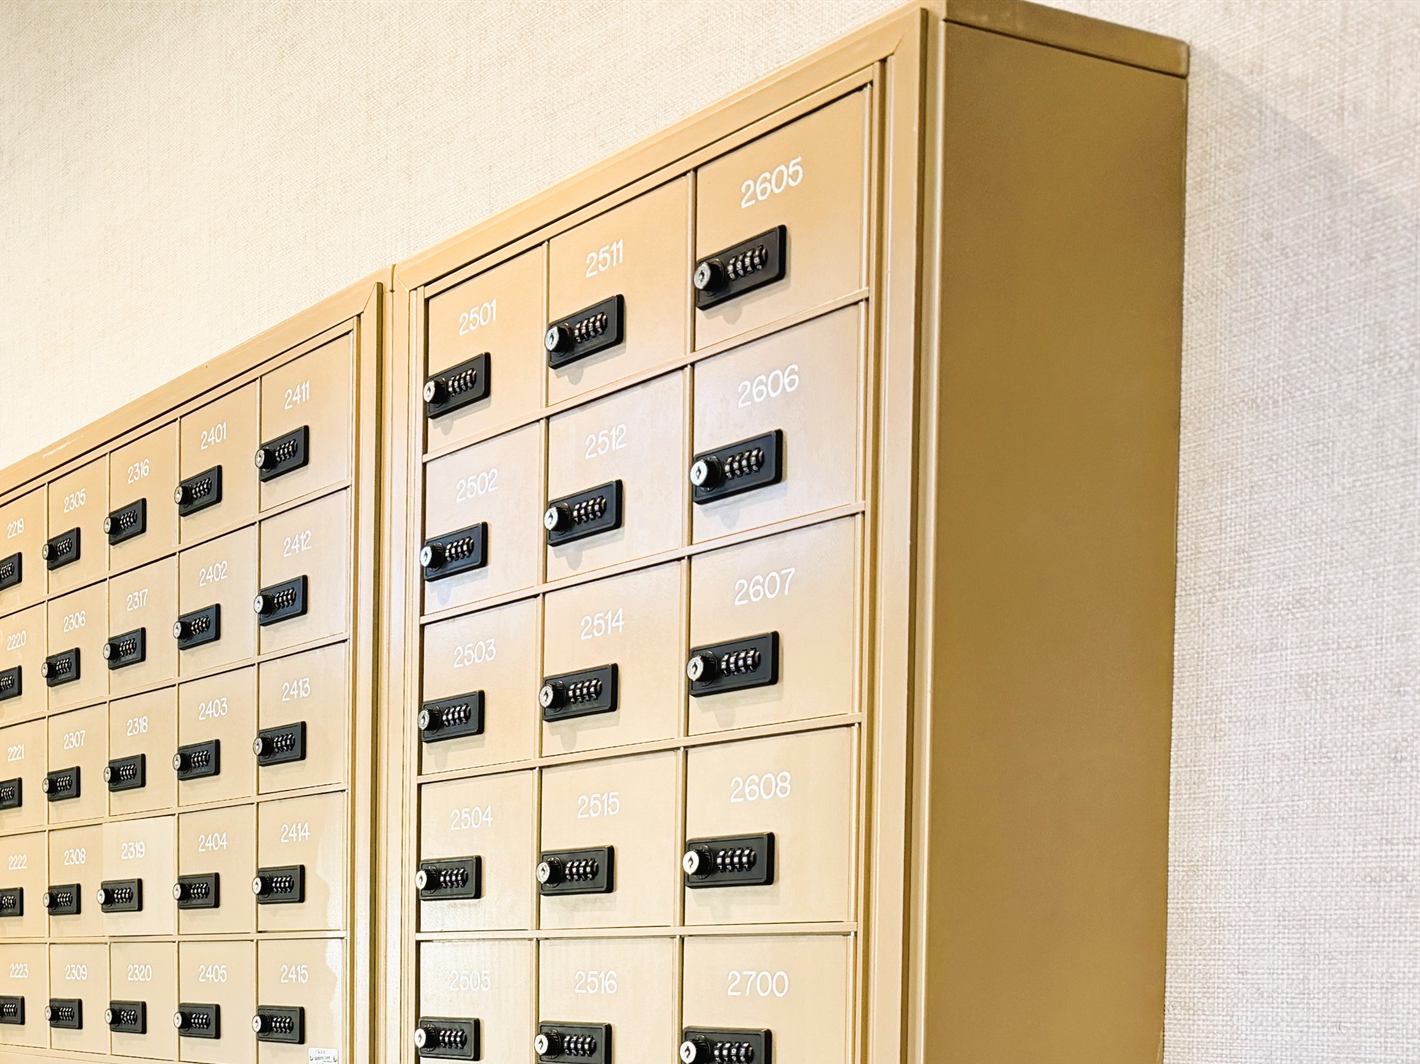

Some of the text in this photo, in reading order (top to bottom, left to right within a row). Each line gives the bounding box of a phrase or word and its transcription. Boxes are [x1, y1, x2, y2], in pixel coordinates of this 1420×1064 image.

[741, 156, 803, 209] 2605
[585, 239, 623, 279] 2511
[458, 298, 497, 336] 2501
[284, 380, 310, 410] 2411
[737, 364, 799, 409] 2606
[200, 421, 227, 450] 2401
[585, 423, 628, 459] 2512
[127, 458, 150, 484] 2316
[456, 468, 499, 503] 2502
[63, 488, 86, 513] 2305
[7, 517, 25, 539] 2219
[283, 529, 312, 558] 2412
[199, 560, 228, 587] 2402
[734, 567, 796, 606] 2607
[126, 588, 149, 612] 2317
[63, 610, 86, 633] 2306
[580, 607, 625, 641] 2514
[6, 630, 27, 651] 2220
[453, 638, 497, 669] 2503
[282, 677, 311, 702] 2413
[198, 697, 228, 721] 2403
[126, 715, 149, 737] 2318
[63, 729, 86, 750] 2307
[7, 744, 25, 762] 2221
[730, 771, 791, 803] 2608
[577, 791, 621, 819] 2515
[450, 805, 493, 831] 2504
[198, 832, 228, 853] 2404
[280, 822, 310, 843] 2414
[8, 854, 28, 871] 2222
[64, 847, 86, 866] 2308
[121, 841, 146, 860] 2319
[9, 963, 29, 979] 2223
[65, 964, 88, 981] 2309
[127, 964, 152, 982] 2320
[198, 964, 228, 983] 2405
[280, 964, 309, 984] 2415
[447, 967, 491, 992] 2505
[574, 970, 618, 994] 2516
[727, 970, 789, 998] 2700
